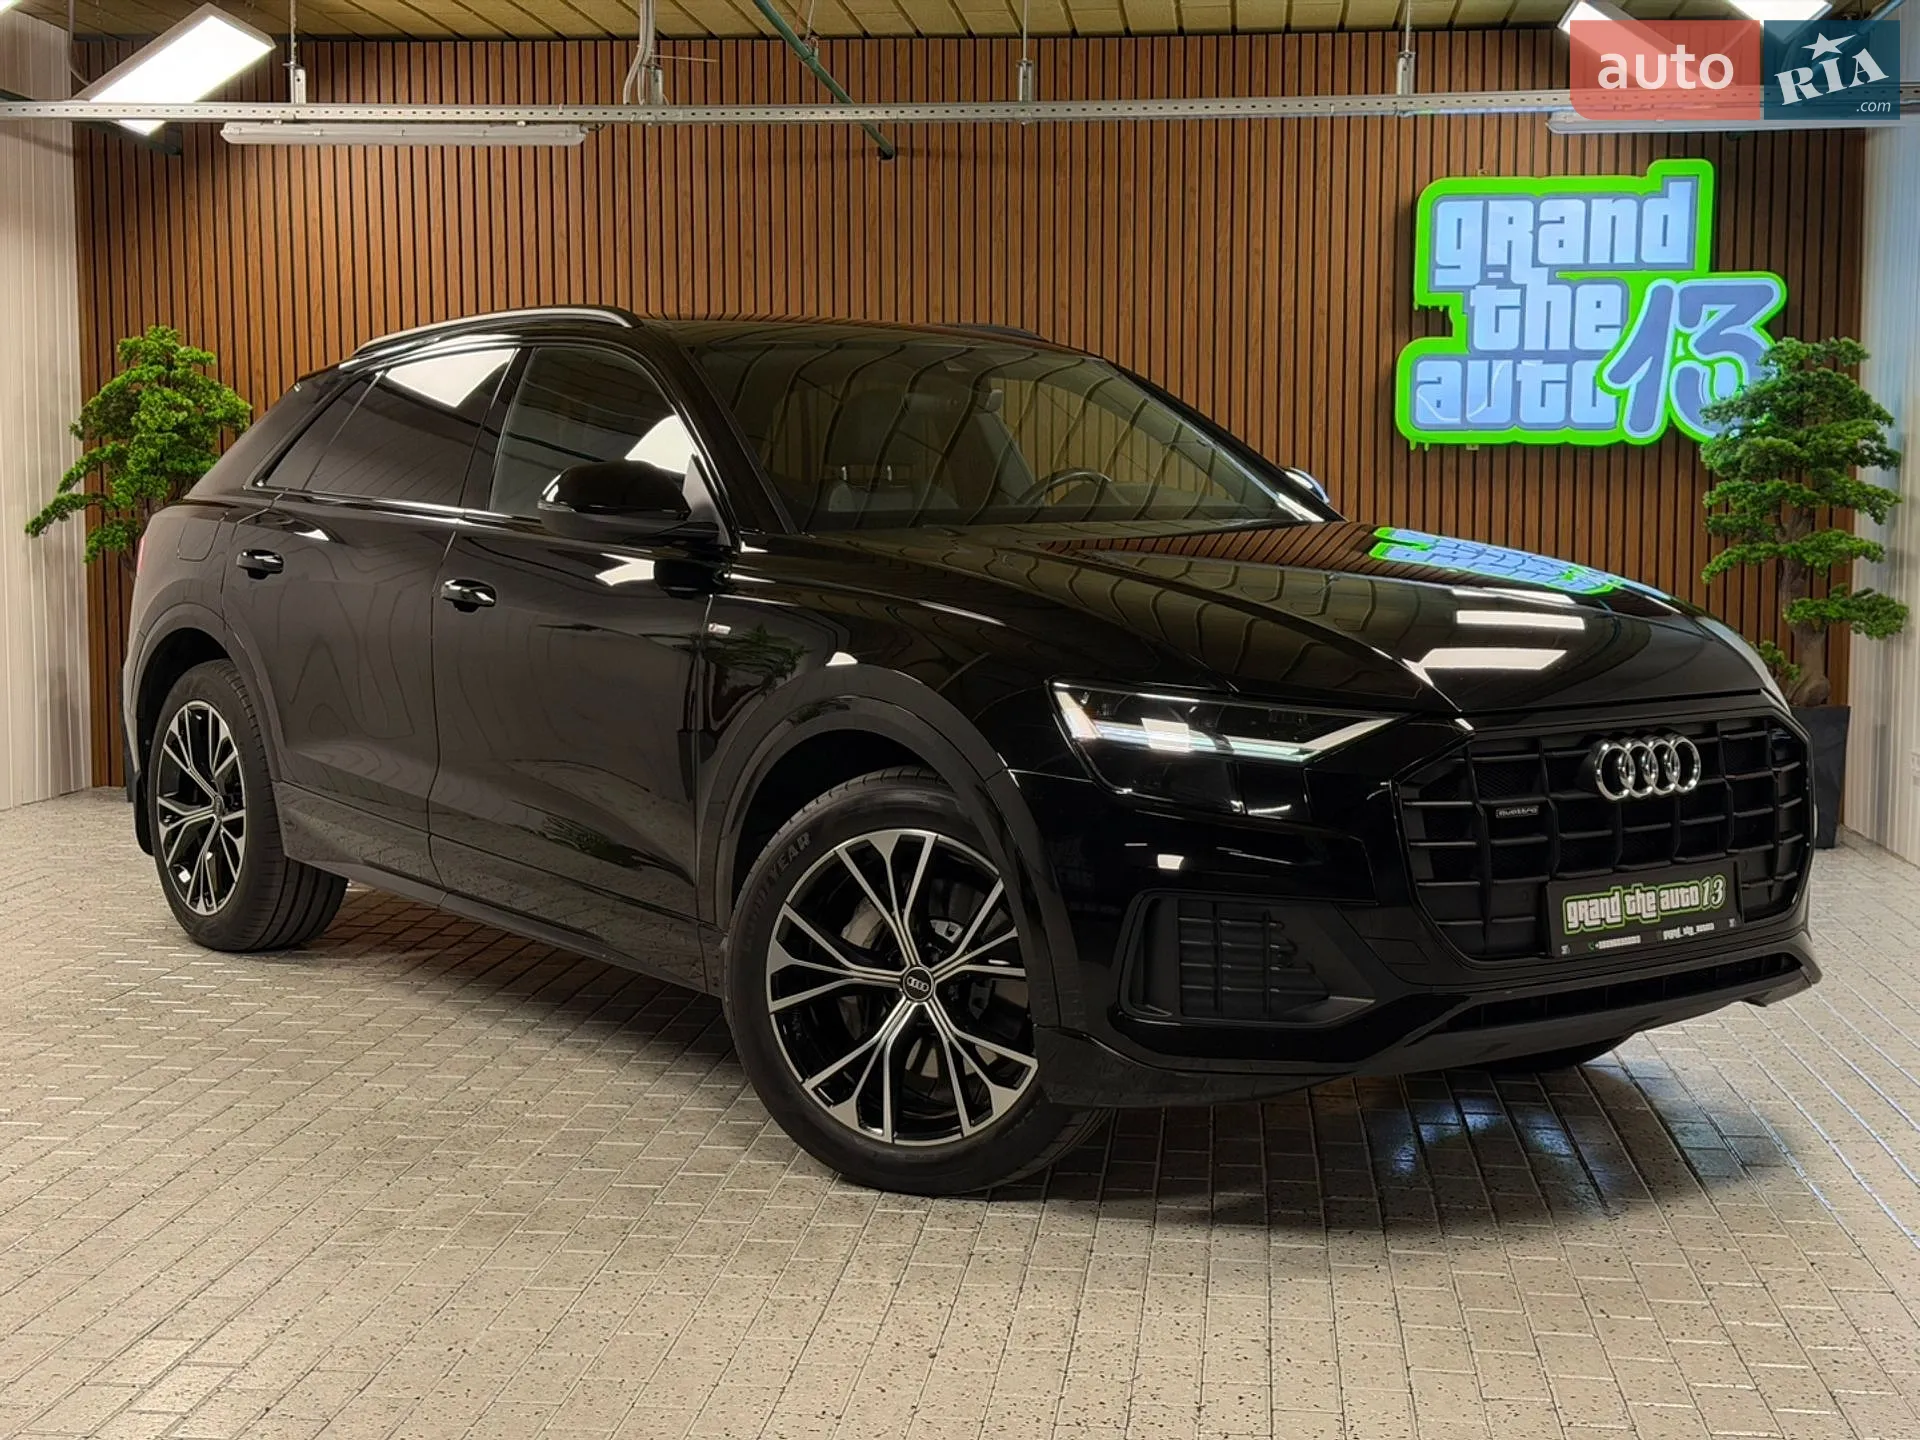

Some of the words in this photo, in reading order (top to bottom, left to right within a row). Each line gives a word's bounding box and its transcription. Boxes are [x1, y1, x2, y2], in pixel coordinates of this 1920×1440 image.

[1434, 181, 1695, 287] grand
[1470, 268, 1623, 351] the
[1415, 359, 1619, 426] auto
[1602, 278, 1780, 438] 13
[1566, 890, 1622, 929] grand
[1624, 888, 1657, 919] the
[1660, 885, 1700, 911] auto
[1701, 878, 1724, 908] 13
